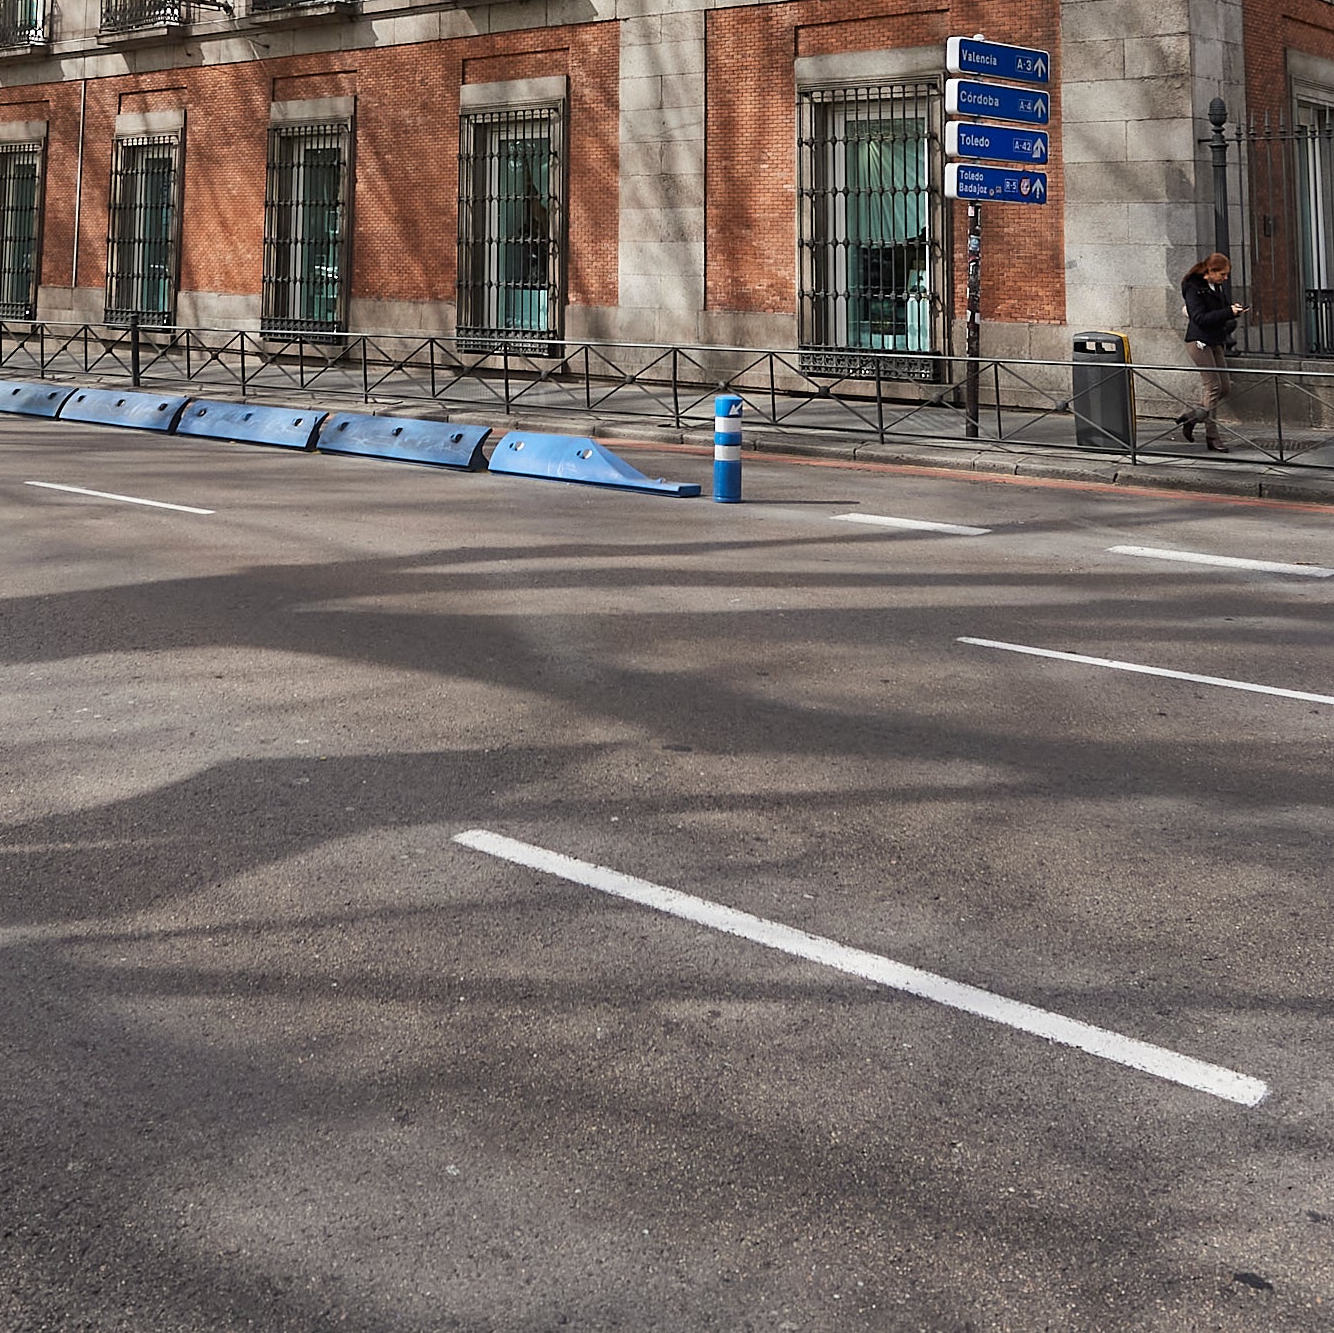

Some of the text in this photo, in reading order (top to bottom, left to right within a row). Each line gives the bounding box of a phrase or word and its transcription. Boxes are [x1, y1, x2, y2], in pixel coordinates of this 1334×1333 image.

[961, 49, 1032, 71] Valencia A-3
[960, 90, 1032, 110] Córdoba A-4
[960, 133, 1031, 151] Toledo A-42
[959, 170, 984, 181] Toledo
[959, 182, 988, 195] Badajoz
